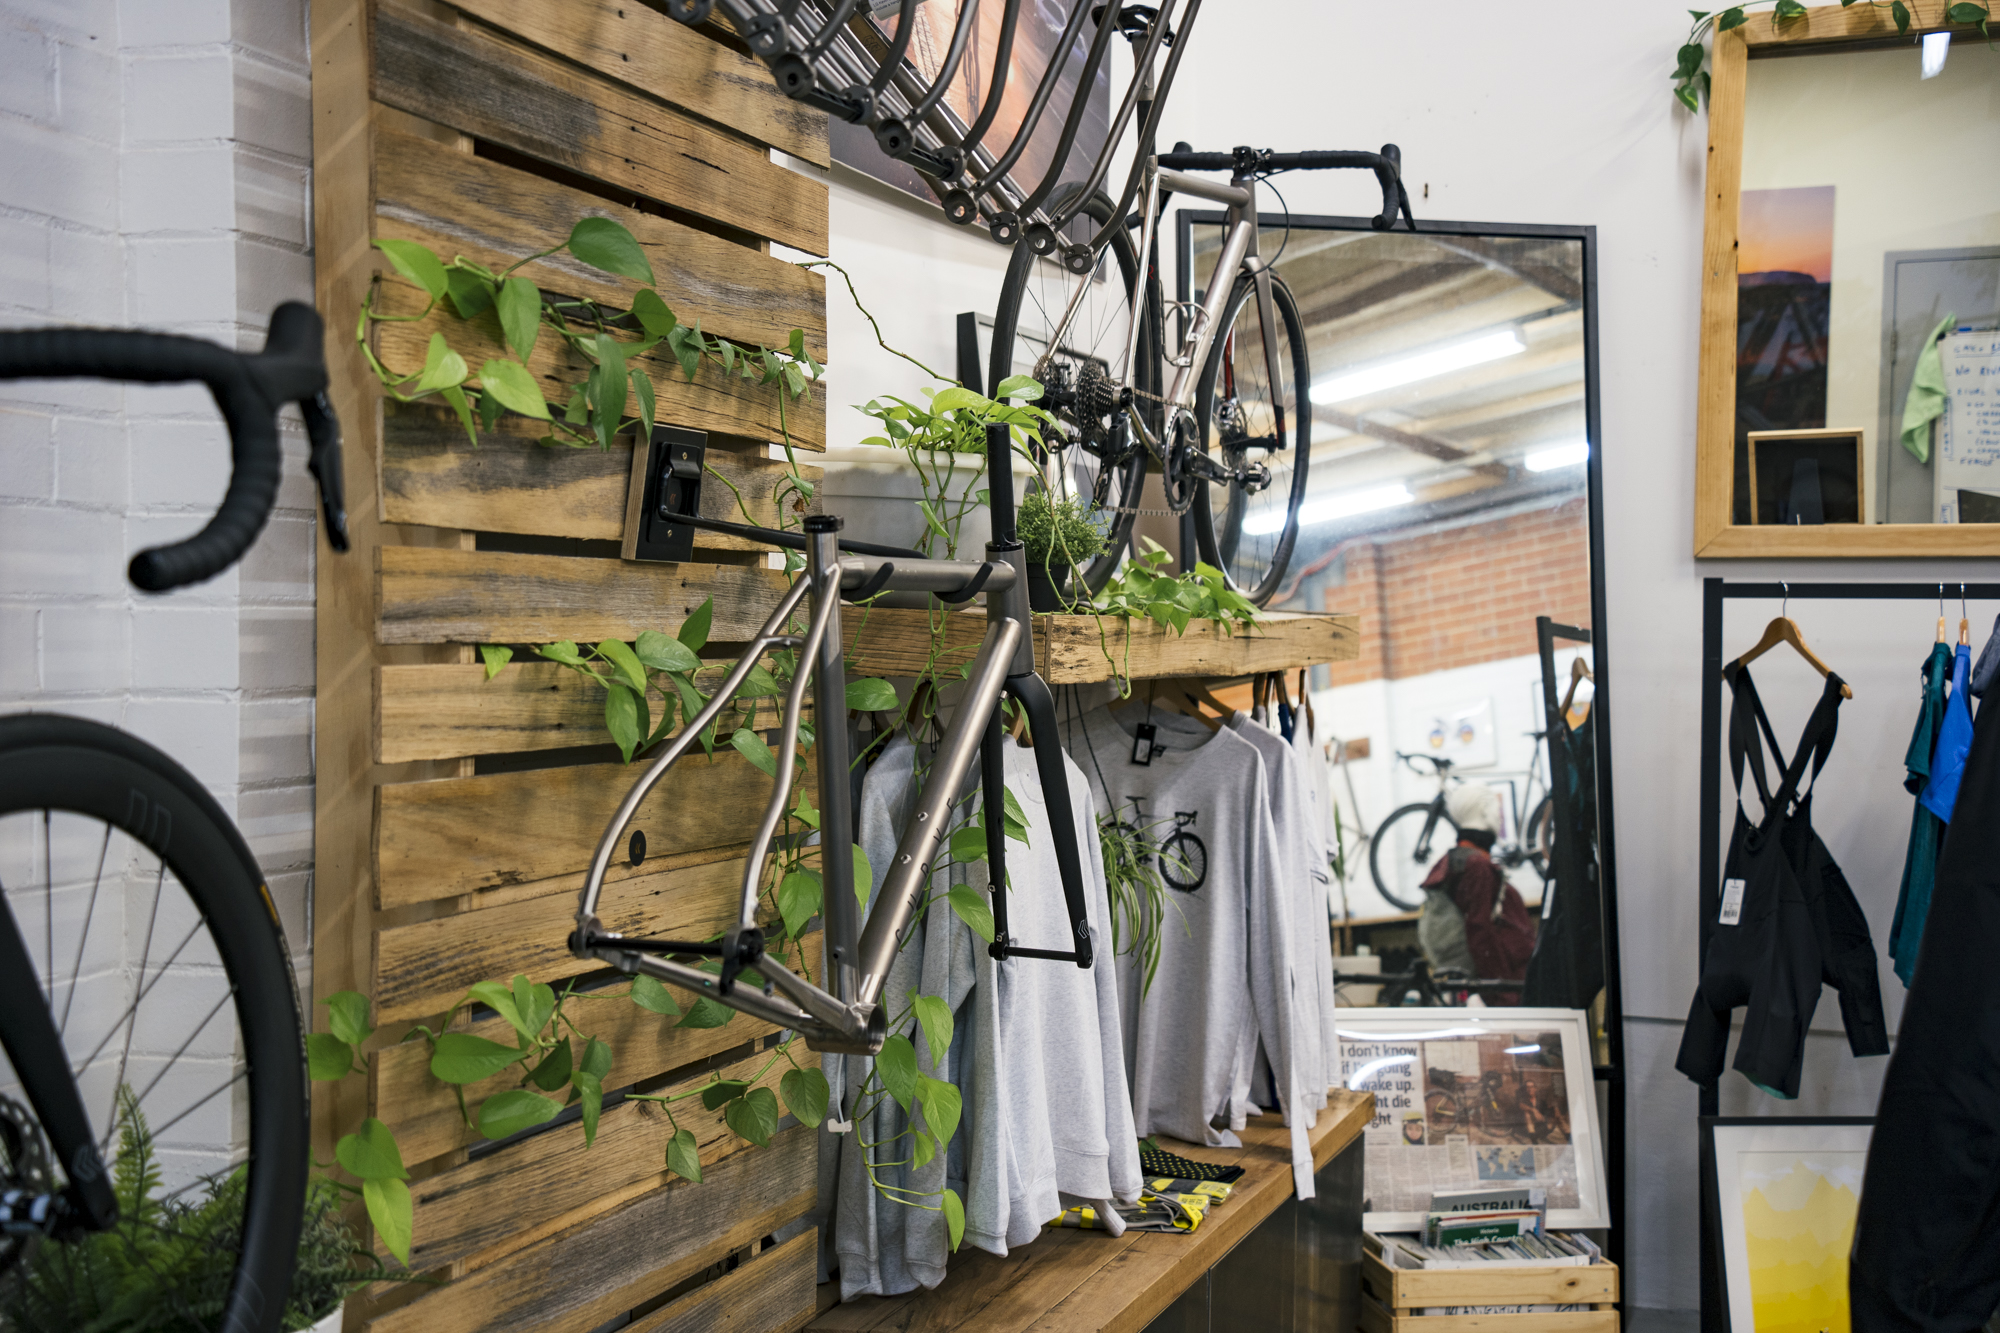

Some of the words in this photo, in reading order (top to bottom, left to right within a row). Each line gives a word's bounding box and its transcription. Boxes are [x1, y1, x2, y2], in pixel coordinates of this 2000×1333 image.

[1348, 1044, 1379, 1057] don't
[1383, 1044, 1417, 1057] know
[1341, 1061, 1350, 1074] if
[1360, 1079, 1392, 1091] wake
[1396, 1081, 1415, 1094] up.
[1392, 1096, 1411, 1108] die
